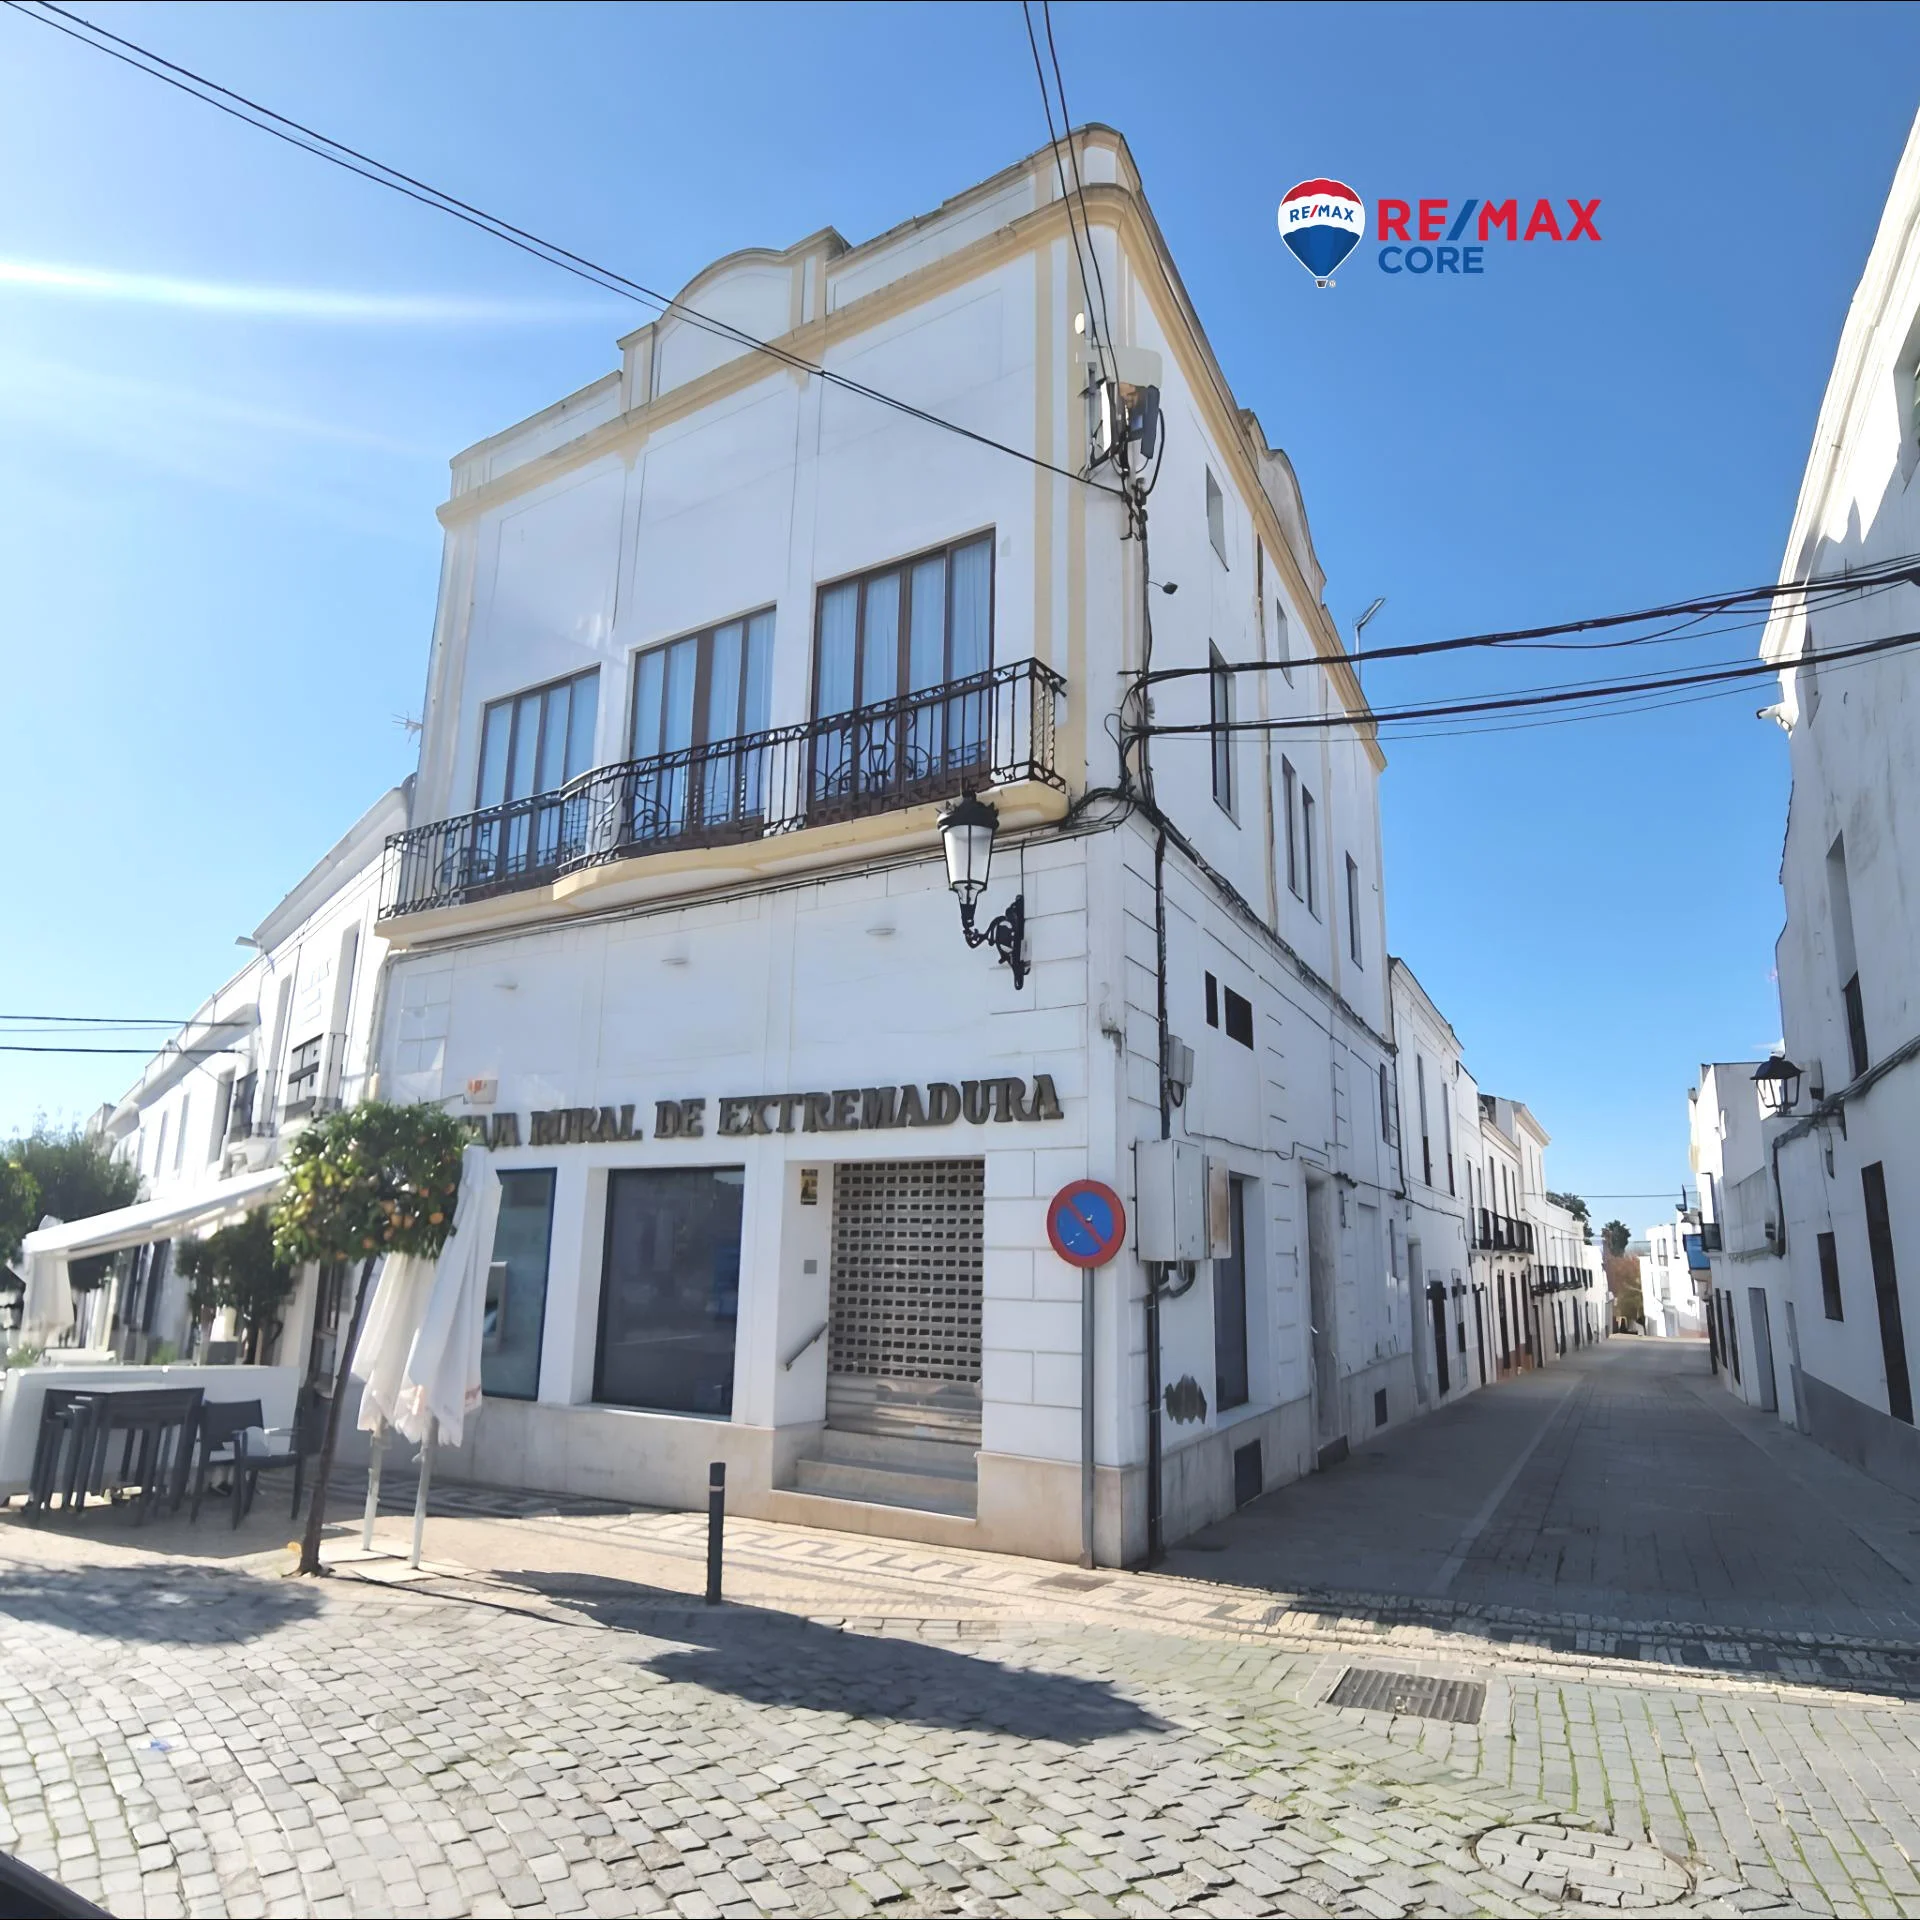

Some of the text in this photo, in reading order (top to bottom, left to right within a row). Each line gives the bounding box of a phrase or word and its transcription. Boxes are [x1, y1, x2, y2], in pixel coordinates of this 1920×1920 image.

[528, 1104, 643, 1146] RURAL
[654, 1098, 706, 1139] DE
[716, 1074, 1064, 1135] EXTREMADURA
